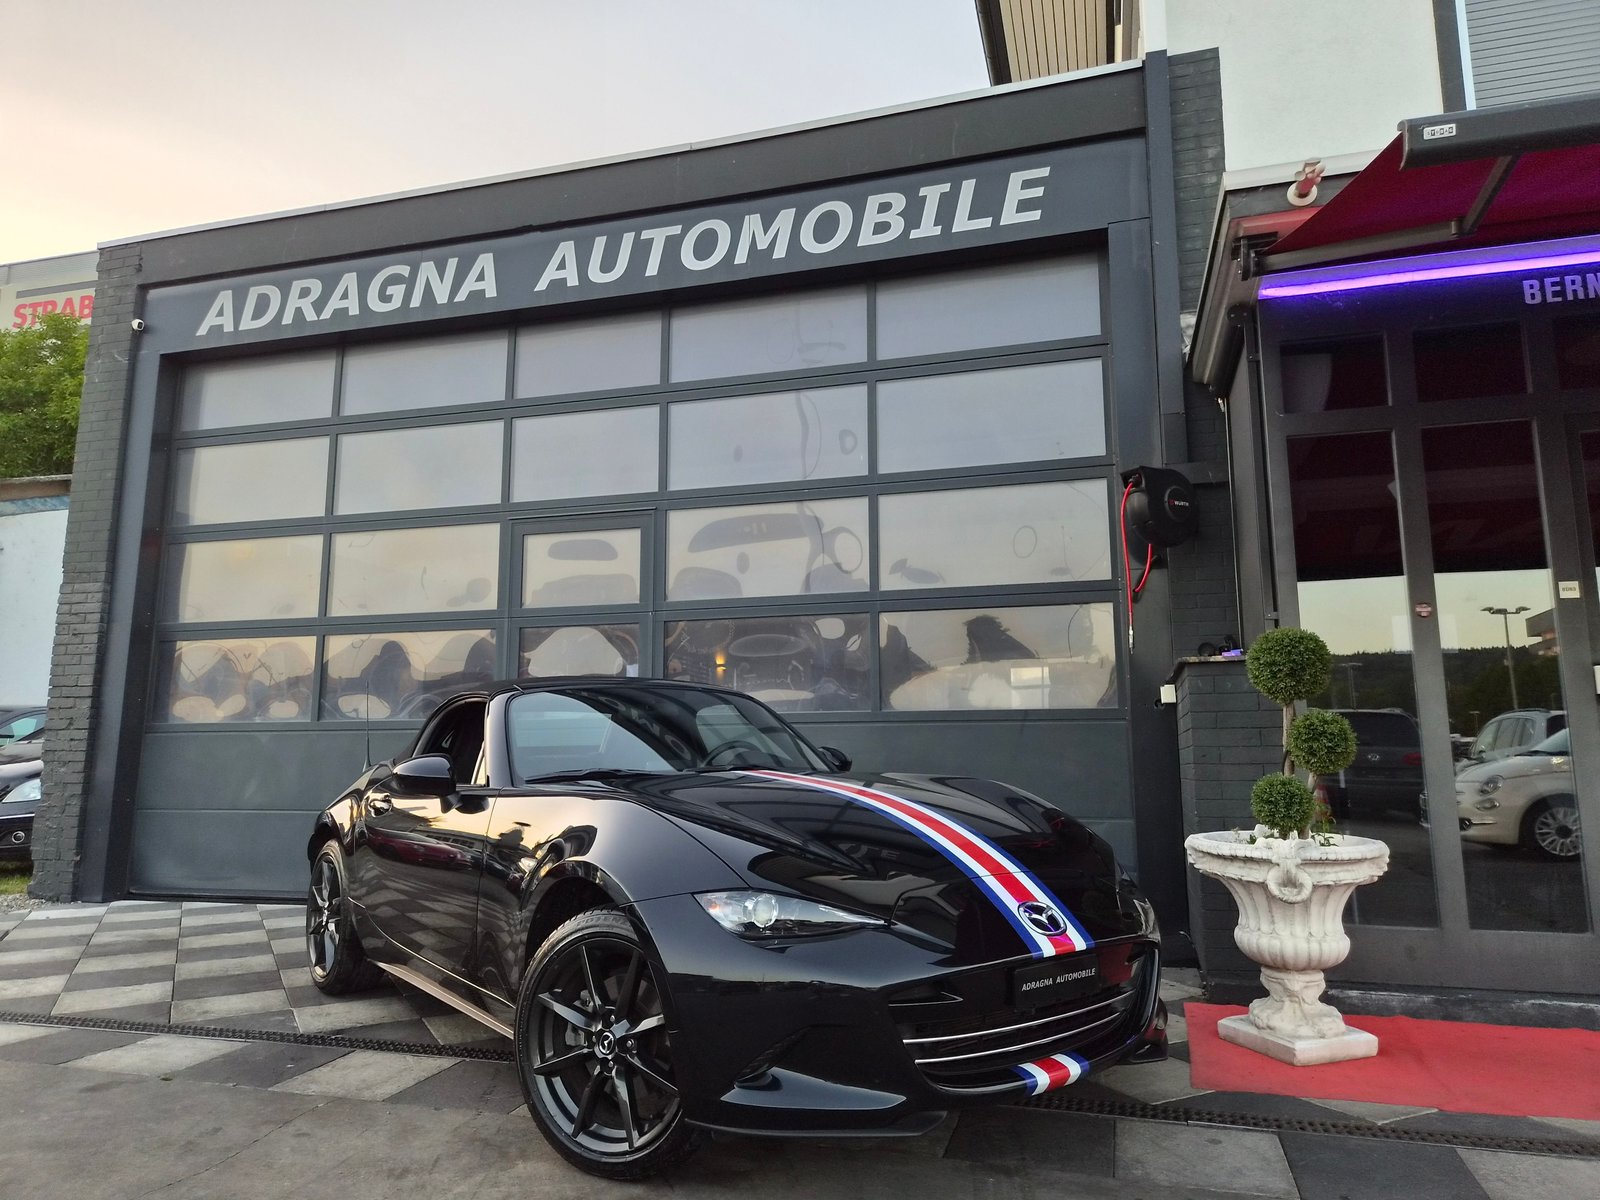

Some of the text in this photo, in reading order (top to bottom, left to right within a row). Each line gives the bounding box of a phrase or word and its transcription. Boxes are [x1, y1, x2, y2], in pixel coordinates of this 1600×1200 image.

[195, 166, 1051, 336] ADRAGNA AUTOMOBILE
[1522, 272, 1600, 304] BERN
[1021, 967, 1096, 992] ADRAGNA AUTOMOBILE
